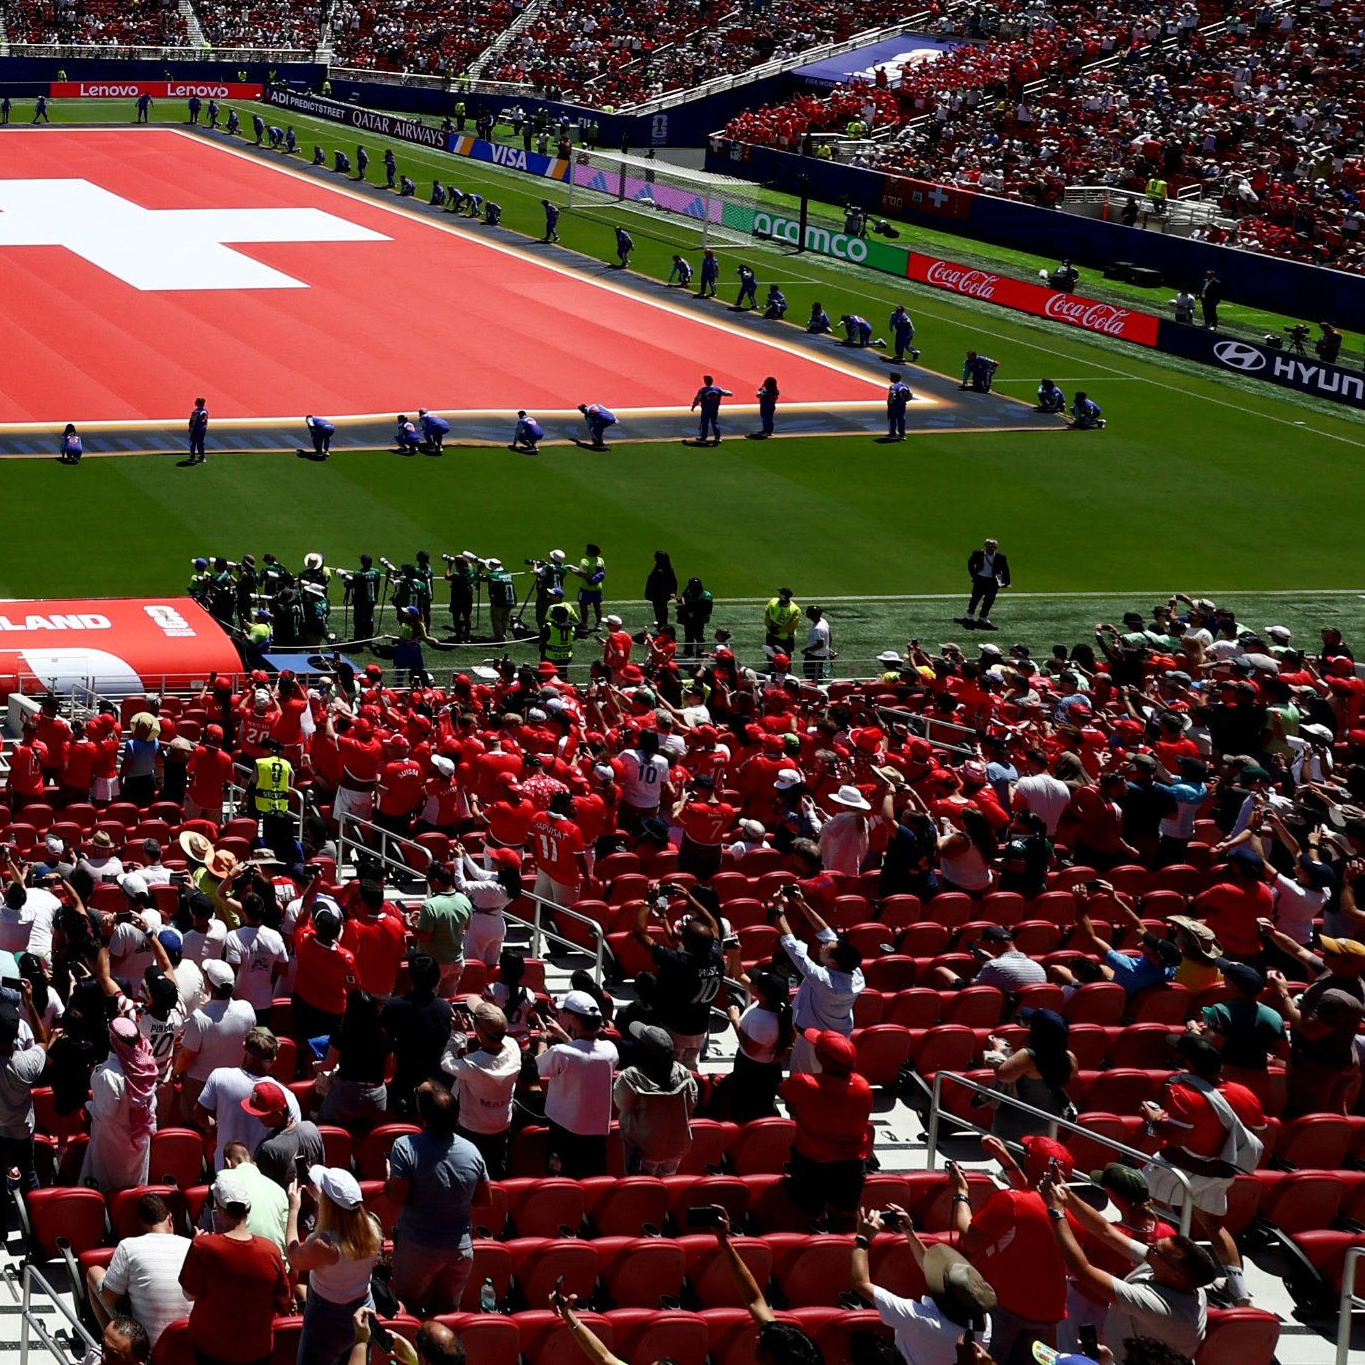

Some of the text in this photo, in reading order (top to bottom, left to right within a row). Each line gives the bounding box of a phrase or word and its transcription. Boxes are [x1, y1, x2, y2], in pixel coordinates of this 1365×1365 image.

[80, 83, 138, 96] Lenovo
[167, 83, 228, 97] Lenovo
[270, 91, 346, 119] ADI PREDICTSTREET
[352, 110, 445, 147] QATAR AIRWAYS
[490, 143, 528, 170] VISA
[753, 213, 868, 263] aramco
[927, 261, 1001, 300] Coca-Cola
[1045, 293, 1131, 335] Coca-Cola
[1274, 356, 1365, 400] HYUN
[638, 764, 657, 785] 10
[710, 820, 725, 840] 7
[540, 833, 558, 863] 11
[692, 976, 721, 1004] 10
[151, 1032, 175, 1058] 10
